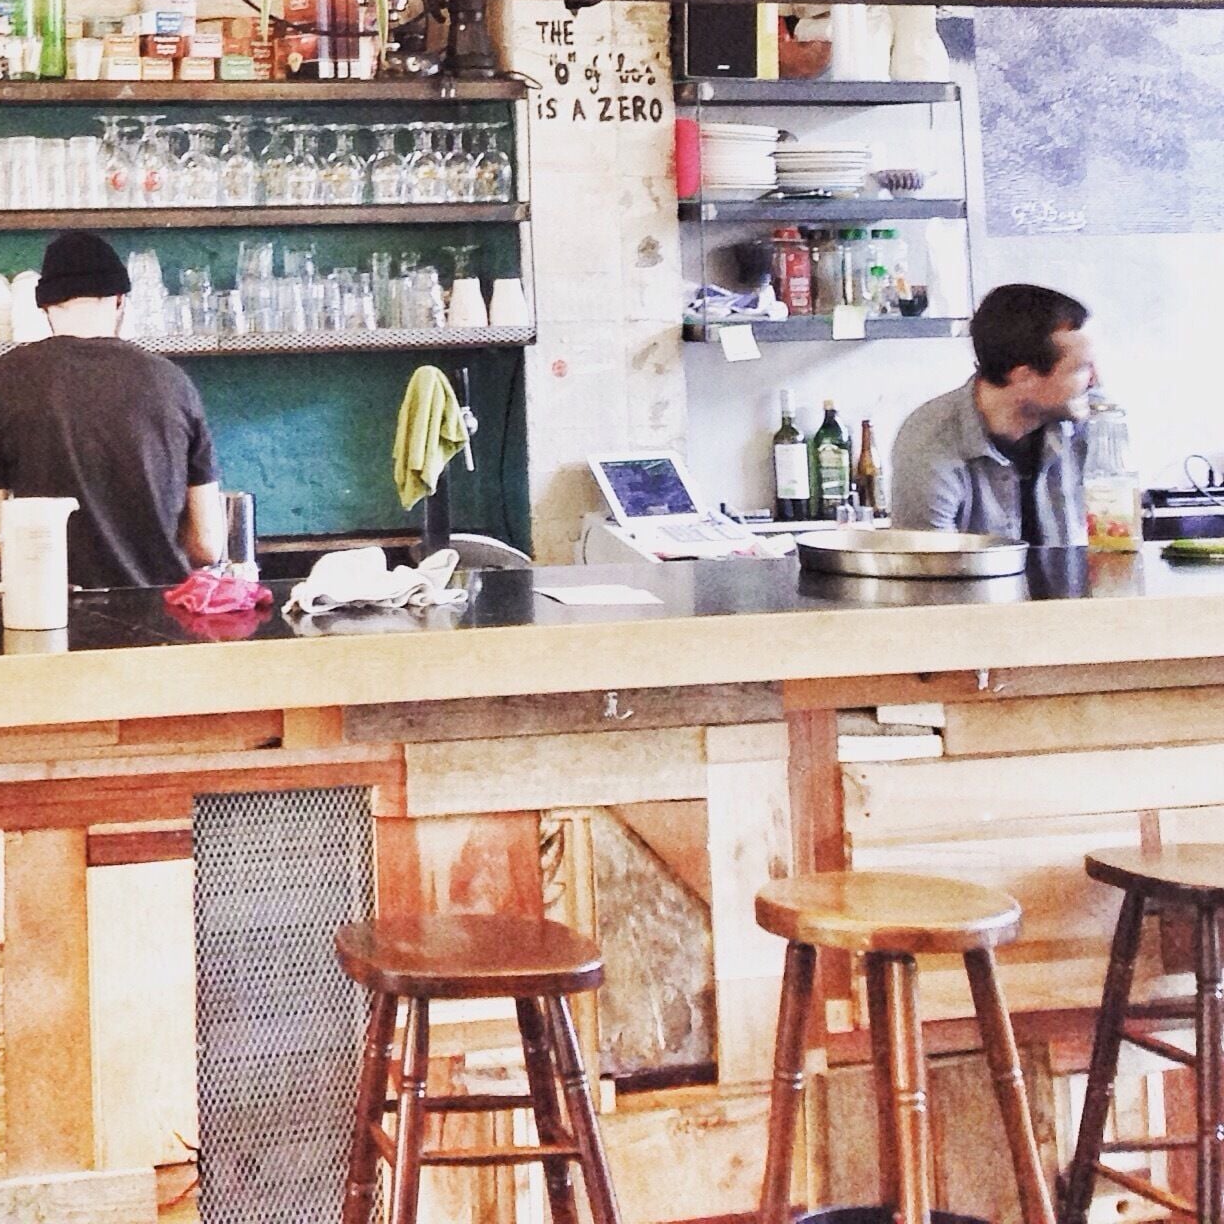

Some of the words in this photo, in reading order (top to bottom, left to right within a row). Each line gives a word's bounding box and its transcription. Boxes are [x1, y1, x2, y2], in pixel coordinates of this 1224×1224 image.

[536, 20, 574, 46] THE
[537, 94, 558, 120] iS
[572, 98, 586, 122] A
[597, 95, 663, 123] ZERO
